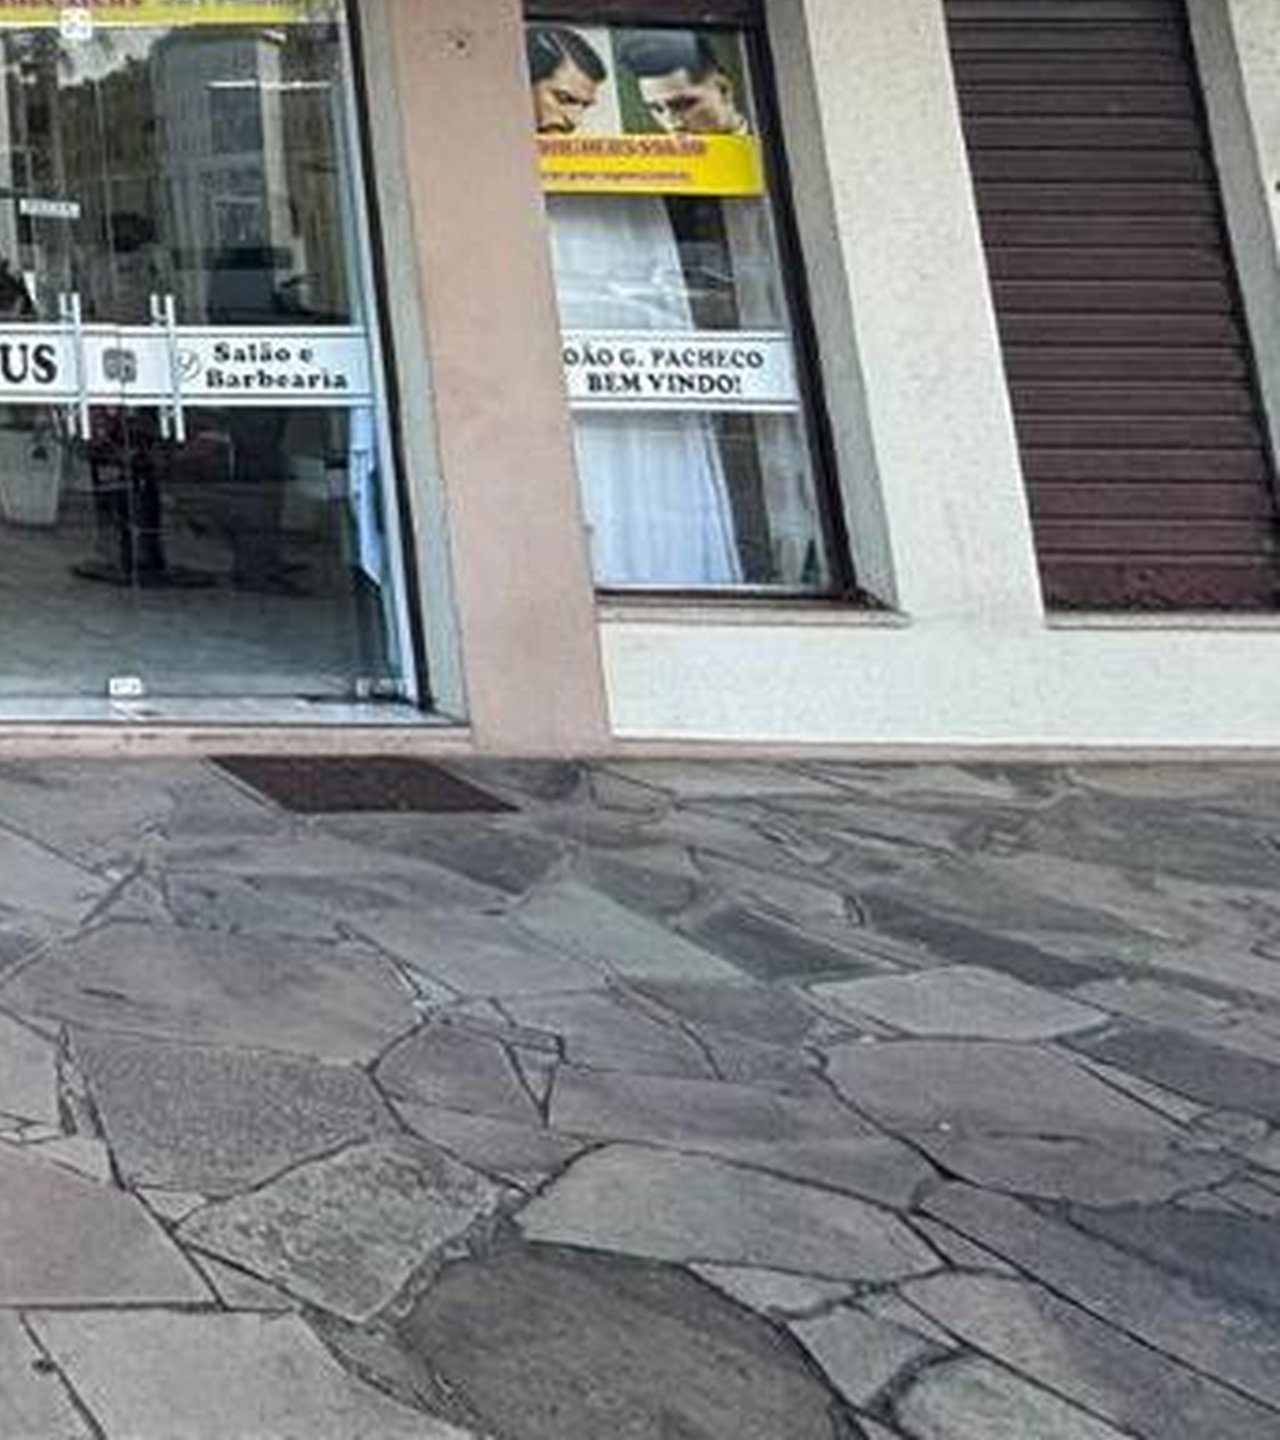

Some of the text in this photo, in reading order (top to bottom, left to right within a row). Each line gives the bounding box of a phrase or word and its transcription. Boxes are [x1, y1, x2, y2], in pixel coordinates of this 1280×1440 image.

[213, 343, 291, 363] Salão
[562, 343, 614, 366] OÃO
[650, 348, 764, 368] PACHECO
[206, 370, 349, 390] Barbearia
[587, 373, 642, 393] BEM
